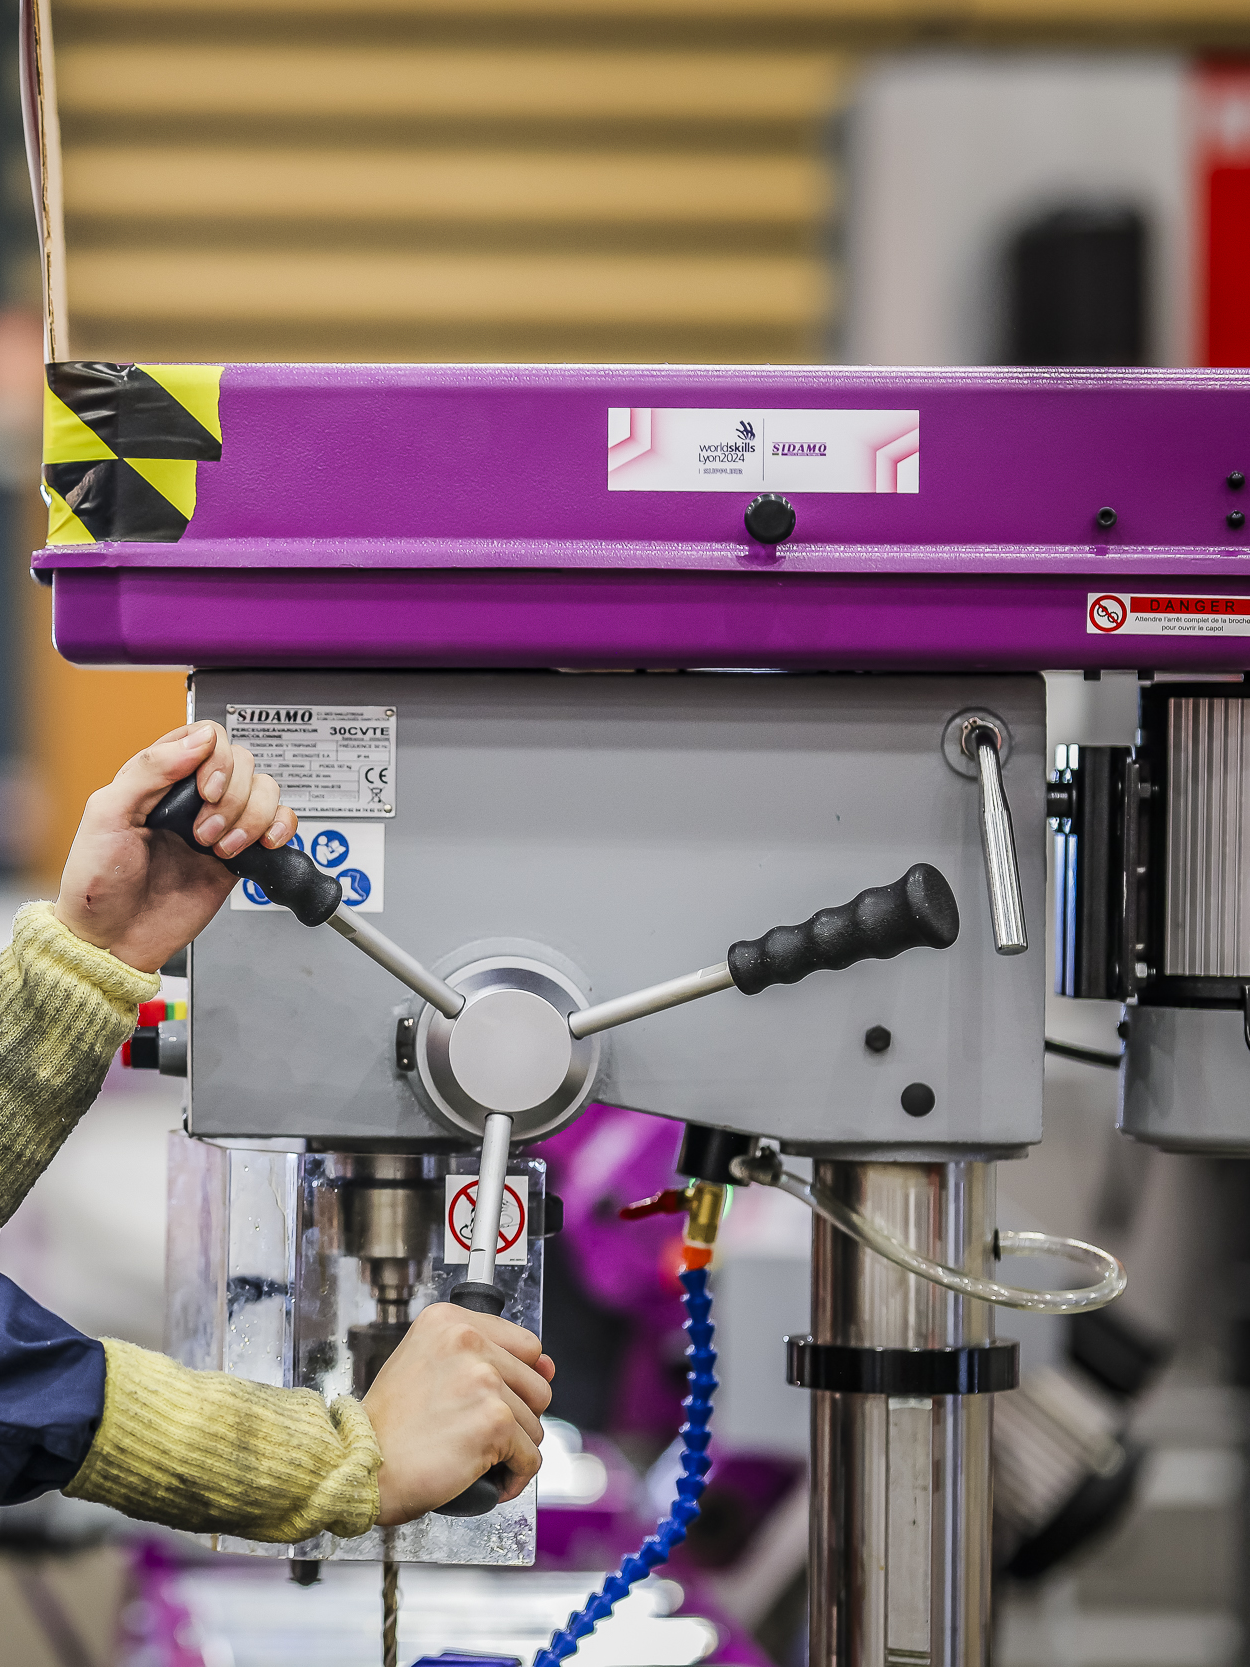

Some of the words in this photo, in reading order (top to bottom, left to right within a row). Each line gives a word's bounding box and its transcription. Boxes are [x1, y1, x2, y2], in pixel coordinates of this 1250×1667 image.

[699, 442, 756, 453] worldskills
[772, 443, 827, 453] SIDAMO
[698, 453, 745, 465] Lyon2024
[1150, 599, 1236, 613] DANGER
[1135, 615, 1162, 623] Attendre
[1184, 617, 1210, 625] complet
[237, 709, 313, 723] SIDAMO
[329, 726, 390, 736] 30CVTE
